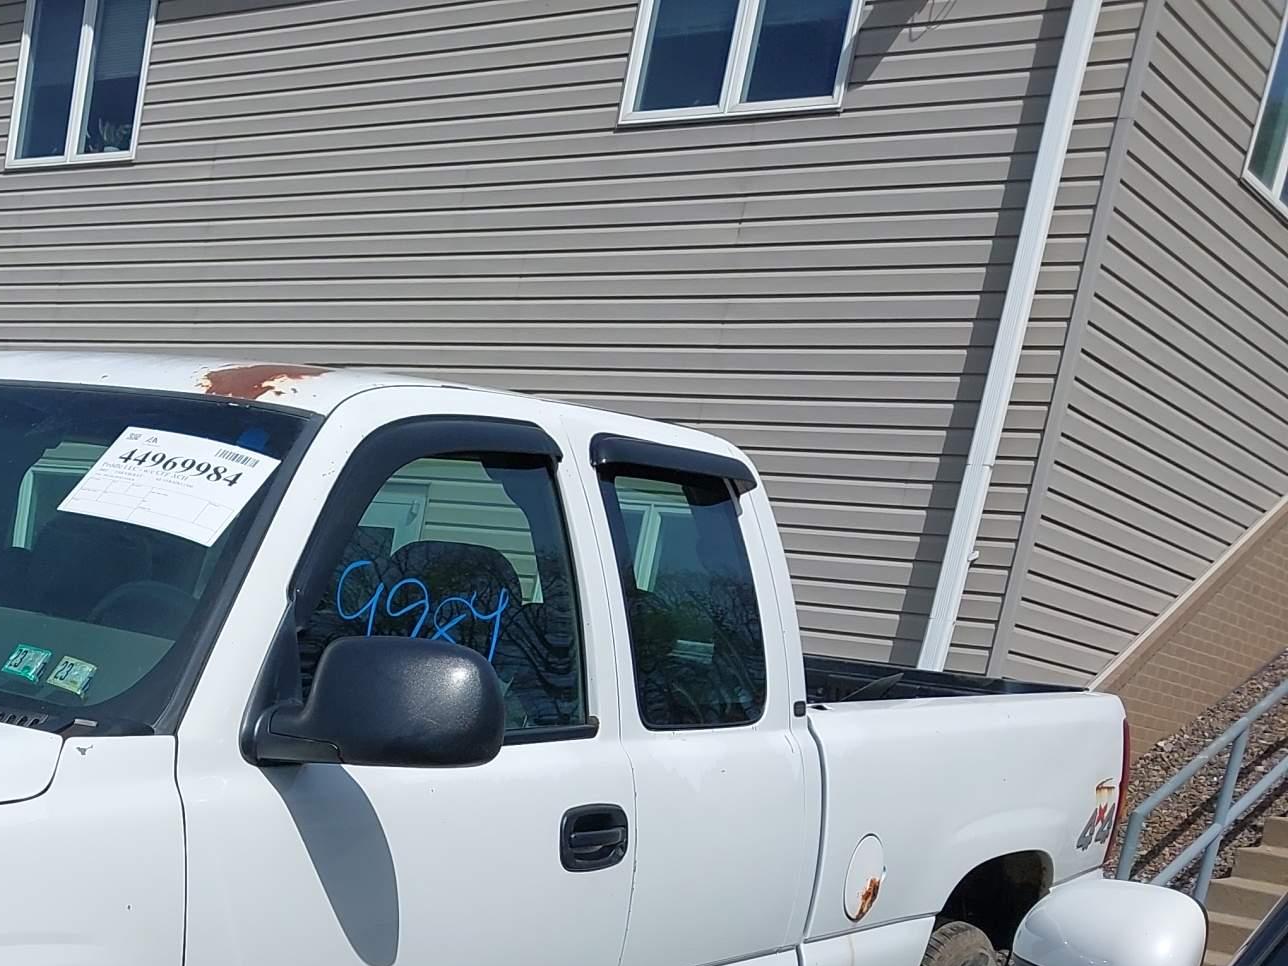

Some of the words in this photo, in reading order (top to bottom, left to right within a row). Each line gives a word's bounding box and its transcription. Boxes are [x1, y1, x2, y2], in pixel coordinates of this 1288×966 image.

[118, 448, 243, 487] 44969984
[336, 560, 509, 663] 9984
[54, 660, 74, 681] 23
